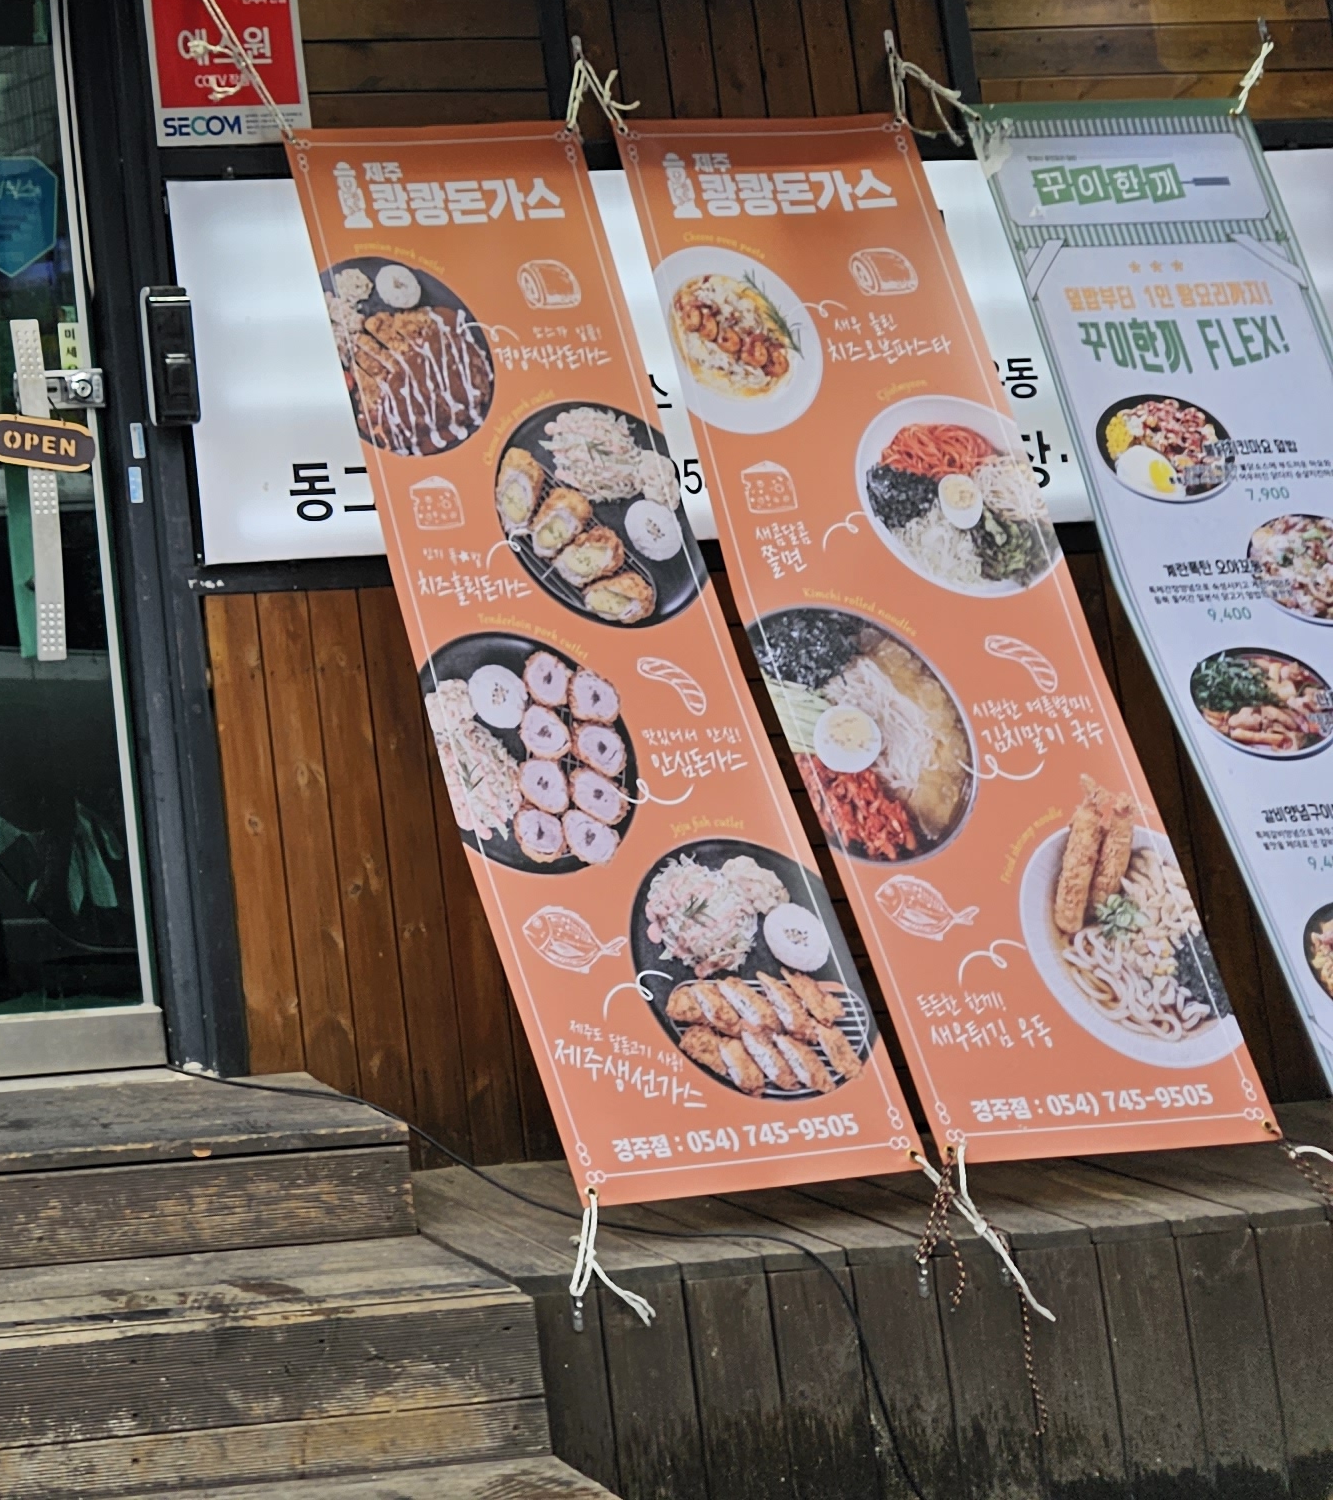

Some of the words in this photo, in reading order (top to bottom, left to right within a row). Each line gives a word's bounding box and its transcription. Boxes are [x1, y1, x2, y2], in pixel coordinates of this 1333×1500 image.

[163, 115, 243, 137] SECOM
[362, 162, 404, 182] 제주
[692, 153, 731, 172] 제주
[698, 169, 897, 216] 쾅쾅돈가스
[1035, 167, 1181, 203] 꾸이한끼
[369, 178, 565, 227] 쾅쾅돈가스
[835, 316, 861, 335] 새우
[868, 312, 898, 336] 올린
[494, 345, 612, 370] 경양식왕돈가스
[826, 334, 952, 365] 치즈오븐파스타
[1077, 317, 1194, 375] 꾸이한끼
[1196, 315, 1290, 371] FLEX!
[3, 430, 77, 457] OPEN
[1245, 486, 1290, 502] 7,900
[755, 521, 812, 546] 새콤달콤
[761, 545, 807, 579] 쫄면
[418, 570, 533, 605] 치즈홀릭돈가스
[802, 587, 841, 602] Kimchi
[844, 595, 876, 613] rolled
[1207, 607, 1252, 622] 9,400
[972, 698, 1022, 720] 시원한
[1025, 695, 1094, 718] 여름별미!
[981, 721, 1065, 755] 김치말이
[1070, 719, 1104, 749] 국수
[650, 750, 749, 778] 안심돈가스
[1261, 803, 1333, 824] 갈비양념구이
[916, 993, 962, 1018] 든든한
[964, 991, 1007, 1015] 한끼!
[568, 1020, 603, 1043] 제주도
[931, 1019, 1014, 1052] 새우튀김
[1018, 1014, 1053, 1049] 우동
[554, 1038, 707, 1108] 제주생선가스
[970, 1097, 1032, 1122] 경주점
[1046, 1091, 1100, 1116] 054)
[1101, 1083, 1214, 1113] 745-9505
[611, 1134, 672, 1163] 경주점
[686, 1127, 740, 1155] 054)
[744, 1113, 859, 1148] 745-9505
